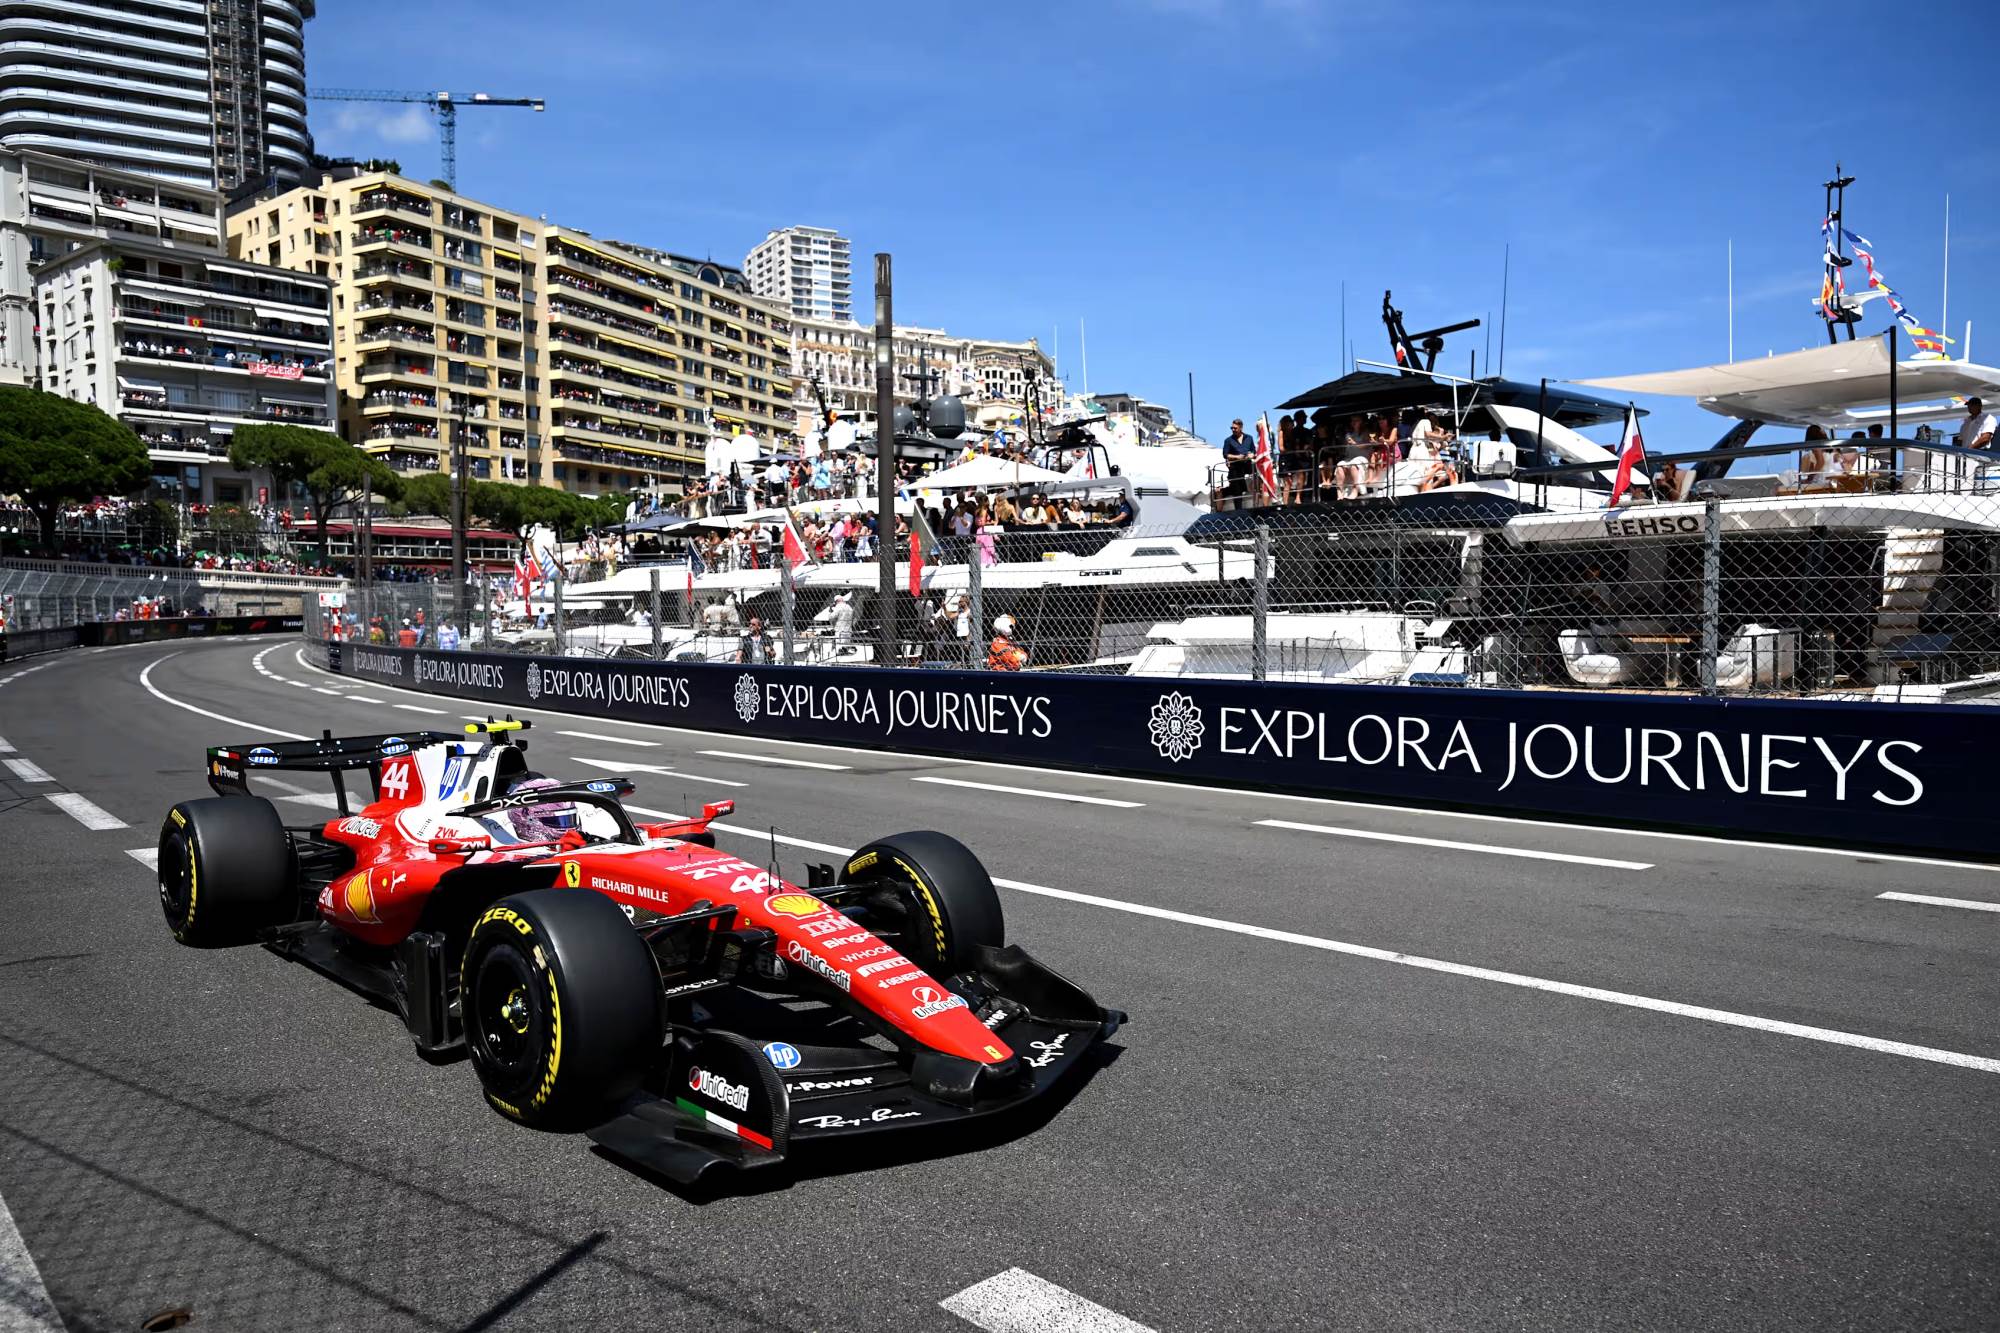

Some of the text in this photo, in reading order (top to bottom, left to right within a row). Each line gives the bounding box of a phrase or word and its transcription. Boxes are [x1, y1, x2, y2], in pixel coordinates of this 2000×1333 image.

[1605, 516, 1699, 537] EEHSO
[358, 651, 377, 671] EXPLORA
[377, 654, 402, 677] JOURNEYS
[422, 659, 504, 690] EXPLORA JOURNEYS
[543, 669, 690, 708] EXPLORA JOURNEYS
[766, 683, 1052, 738] EXPLORA JOURNEYS
[1220, 706, 1924, 806] EXPLORA JOURNEYS
[381, 762, 410, 800] 44
[591, 783, 615, 792] hp
[434, 826, 459, 839] ZYN
[682, 861, 761, 881] ZYN
[729, 872, 785, 894] 44
[591, 876, 669, 903] RICHARD MILLE
[482, 907, 534, 936] ZERO
[797, 915, 861, 938] IBM
[800, 947, 851, 993] UniCredit
[767, 1042, 800, 1069] hp
[700, 1069, 750, 1112] UniCredit
[798, 1108, 922, 1129] Ray-Ban
